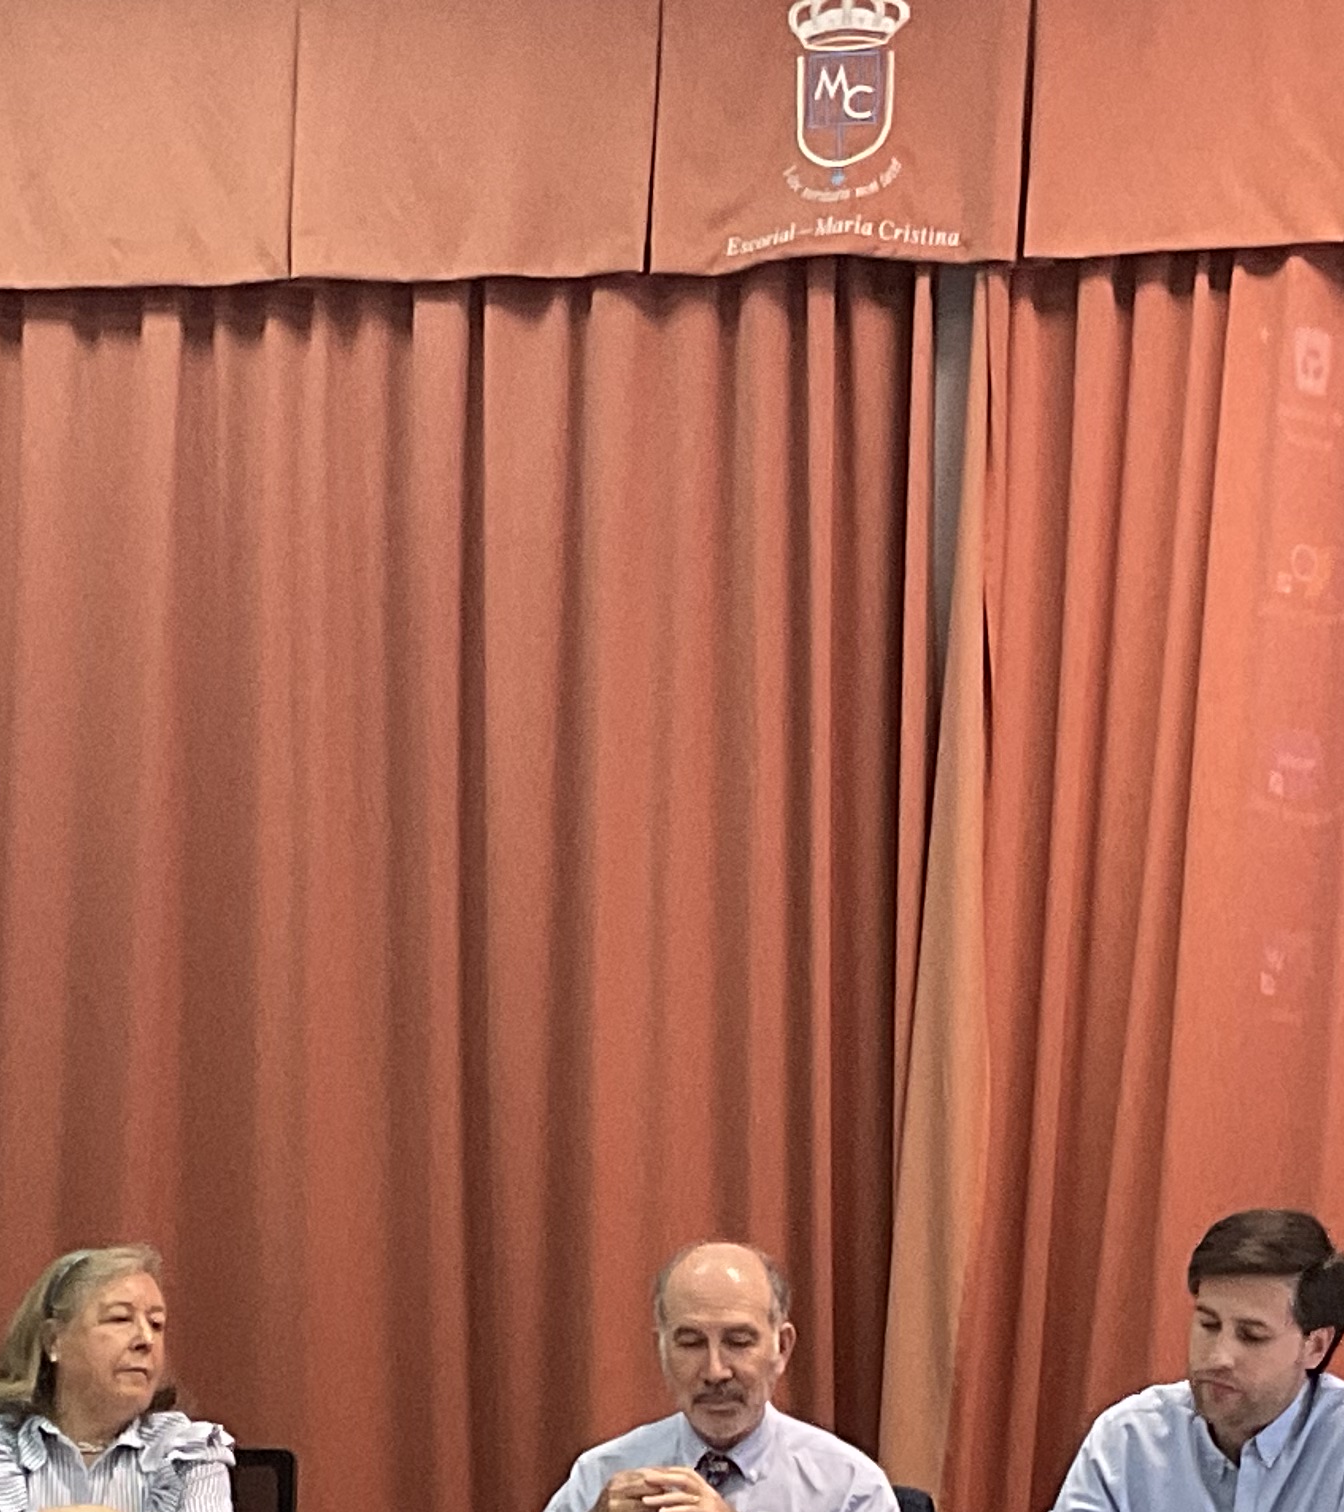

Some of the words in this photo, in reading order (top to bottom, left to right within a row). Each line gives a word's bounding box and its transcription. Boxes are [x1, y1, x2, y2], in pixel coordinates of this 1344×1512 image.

[815, 64, 874, 119] MC
[727, 223, 795, 256] Escorial
[879, 220, 960, 247] Cristina
